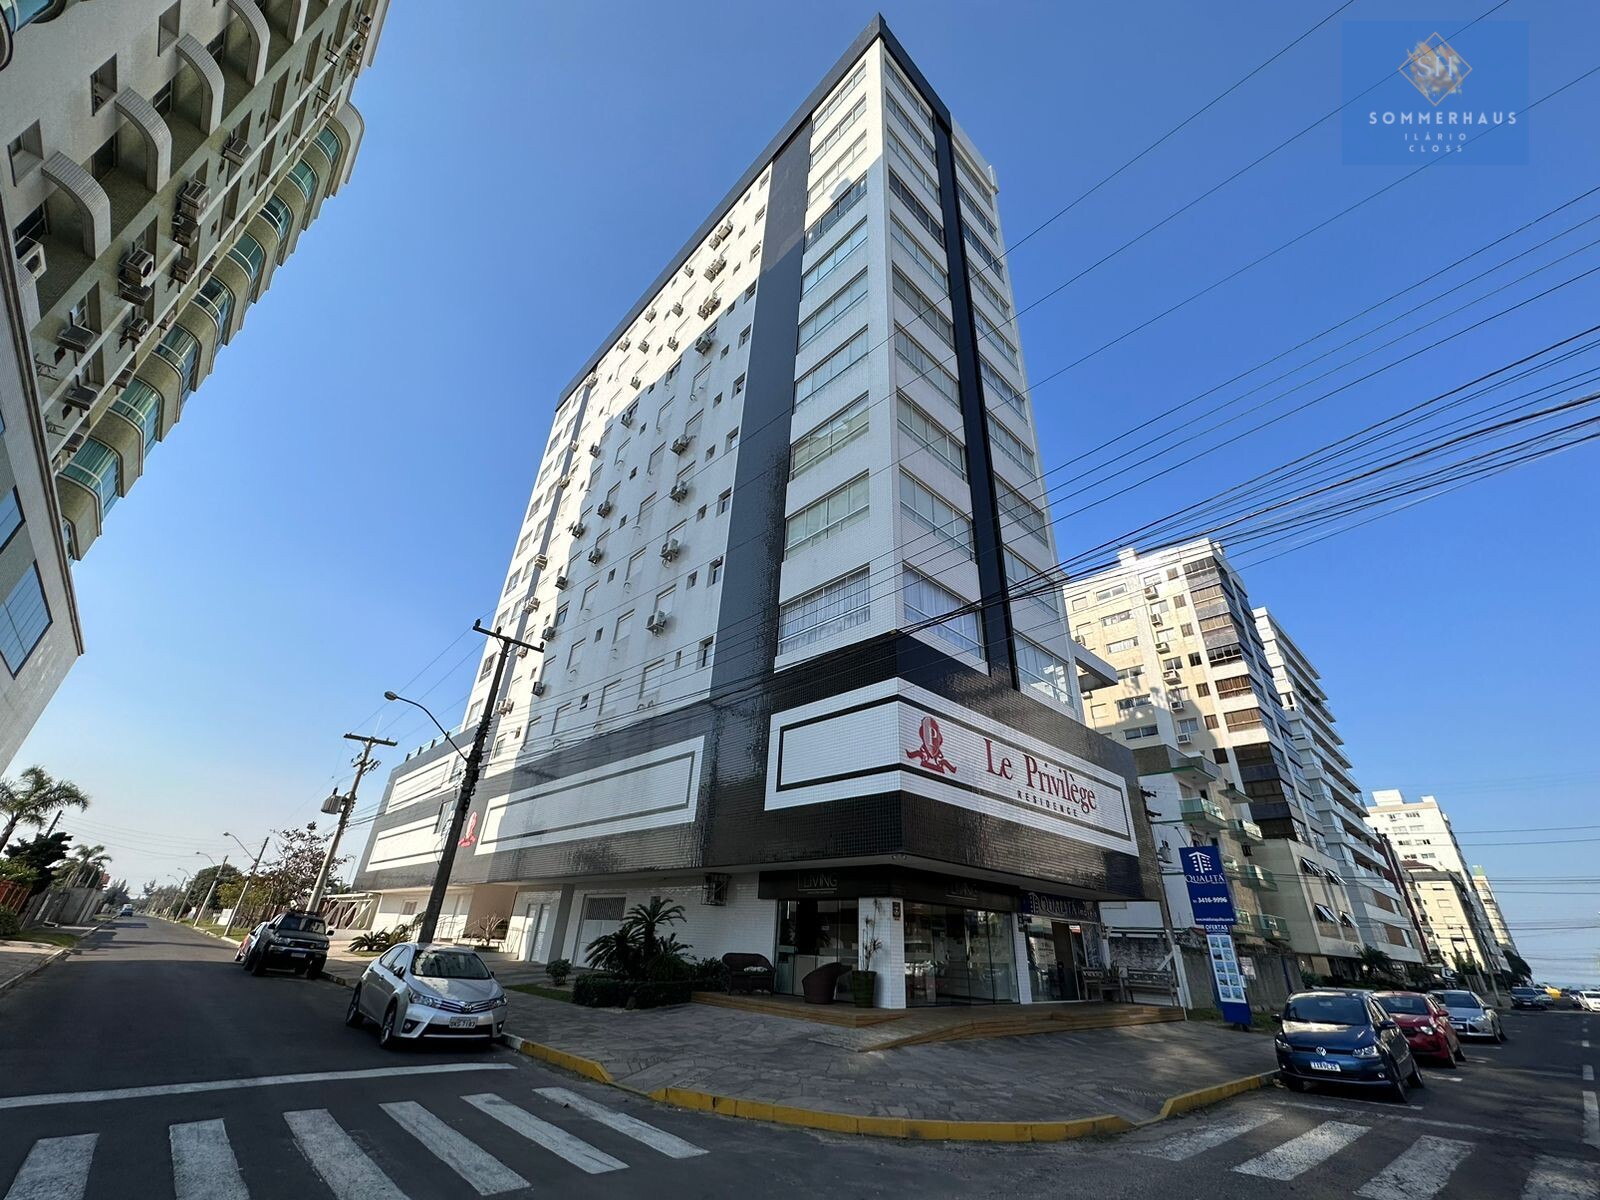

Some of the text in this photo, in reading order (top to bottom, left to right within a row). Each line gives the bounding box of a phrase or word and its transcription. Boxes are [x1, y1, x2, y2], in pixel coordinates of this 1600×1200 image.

[983, 738, 1097, 814] Le Privilège
[1017, 790, 1078, 817] RESIDENCE
[803, 871, 838, 887] LIVING
